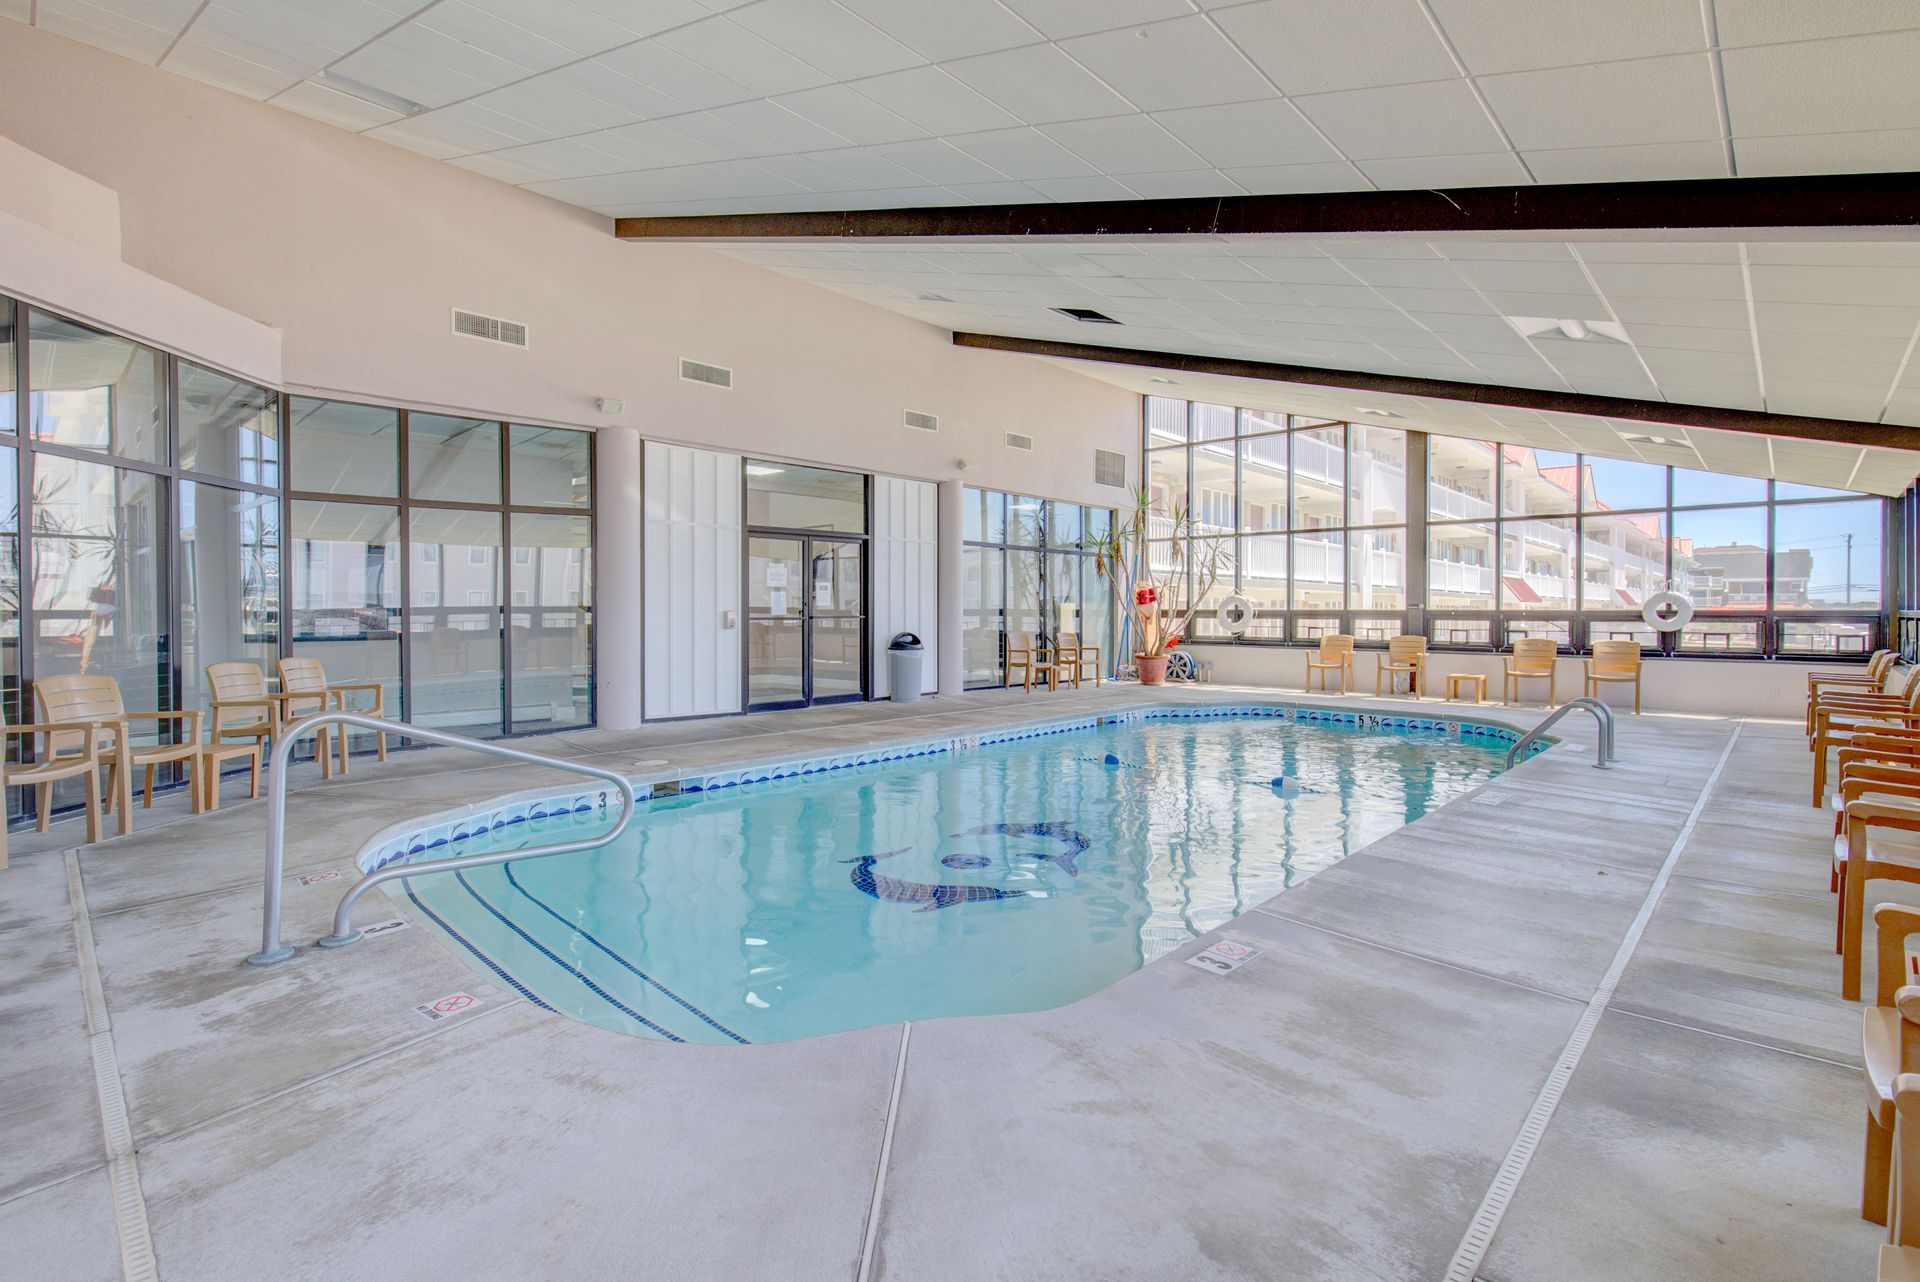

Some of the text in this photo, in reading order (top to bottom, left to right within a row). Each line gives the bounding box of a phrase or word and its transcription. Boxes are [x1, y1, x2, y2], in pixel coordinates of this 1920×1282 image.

[1358, 715, 1364, 724] 5
[950, 739, 956, 751] 3
[598, 791, 607, 808] 3
[364, 922, 404, 934] 3
[1196, 956, 1233, 970] 3
